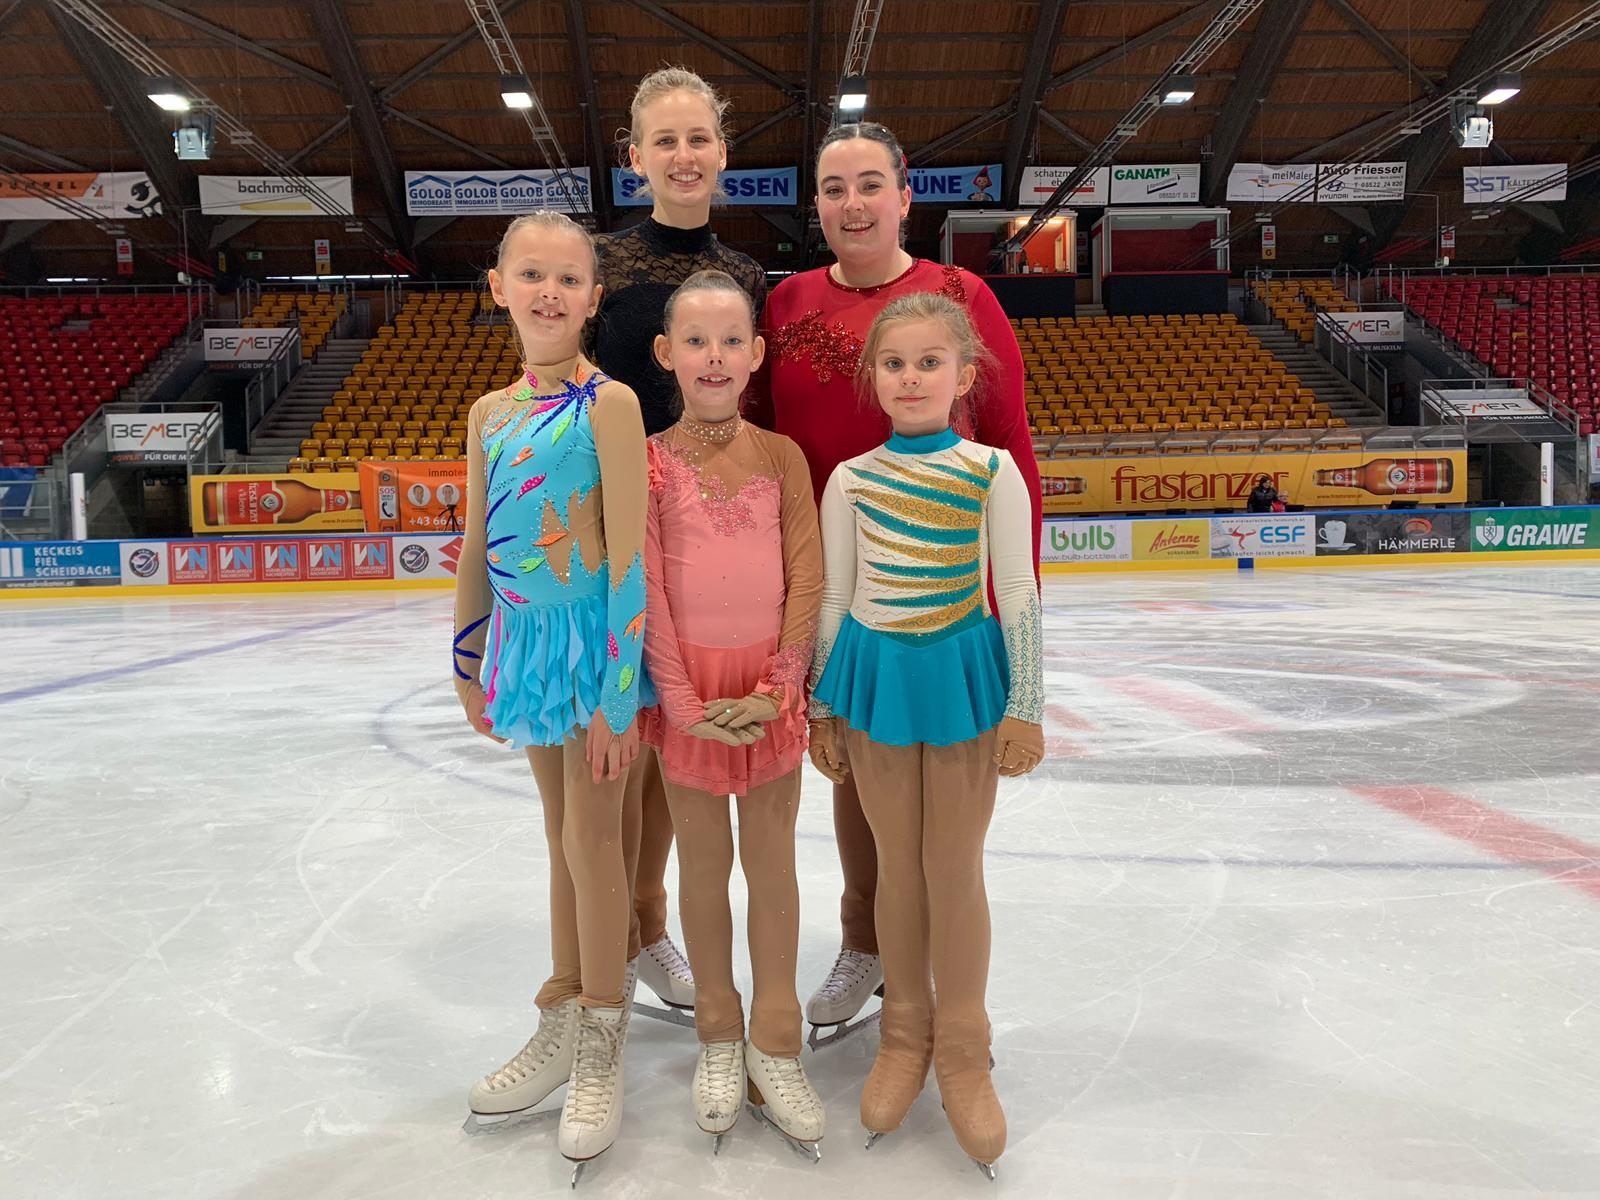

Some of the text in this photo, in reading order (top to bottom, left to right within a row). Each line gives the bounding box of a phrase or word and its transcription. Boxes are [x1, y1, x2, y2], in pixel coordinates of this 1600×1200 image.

[1114, 168, 1170, 180] GANATH
[1272, 170, 1313, 180] meiMaler
[1322, 165, 1404, 175] Auto Friesser
[907, 170, 962, 194] ÜNE
[1465, 176, 1510, 192] RST
[409, 188, 452, 199] GOLOB
[454, 187, 498, 199] GOLOB
[500, 187, 544, 198] GOLOB
[111, 423, 201, 447] BEMER
[144, 452, 161, 460] FÜR
[409, 516, 430, 526] +43
[1051, 525, 1116, 551] bulb
[1149, 524, 1201, 553] Antenne
[1260, 525, 1305, 543] ESF
[1506, 523, 1588, 547] GRAWE
[1378, 537, 1456, 550] HÄMMERLE
[34, 546, 84, 556] KECKEIS
[220, 546, 253, 570] VN
[264, 545, 297, 569] VN
[309, 544, 341, 567] VN
[353, 543, 386, 566] VN
[35, 557, 58, 566] FIEL
[175, 547, 208, 571] VN
[35, 566, 111, 577] SCHEIDBACH
